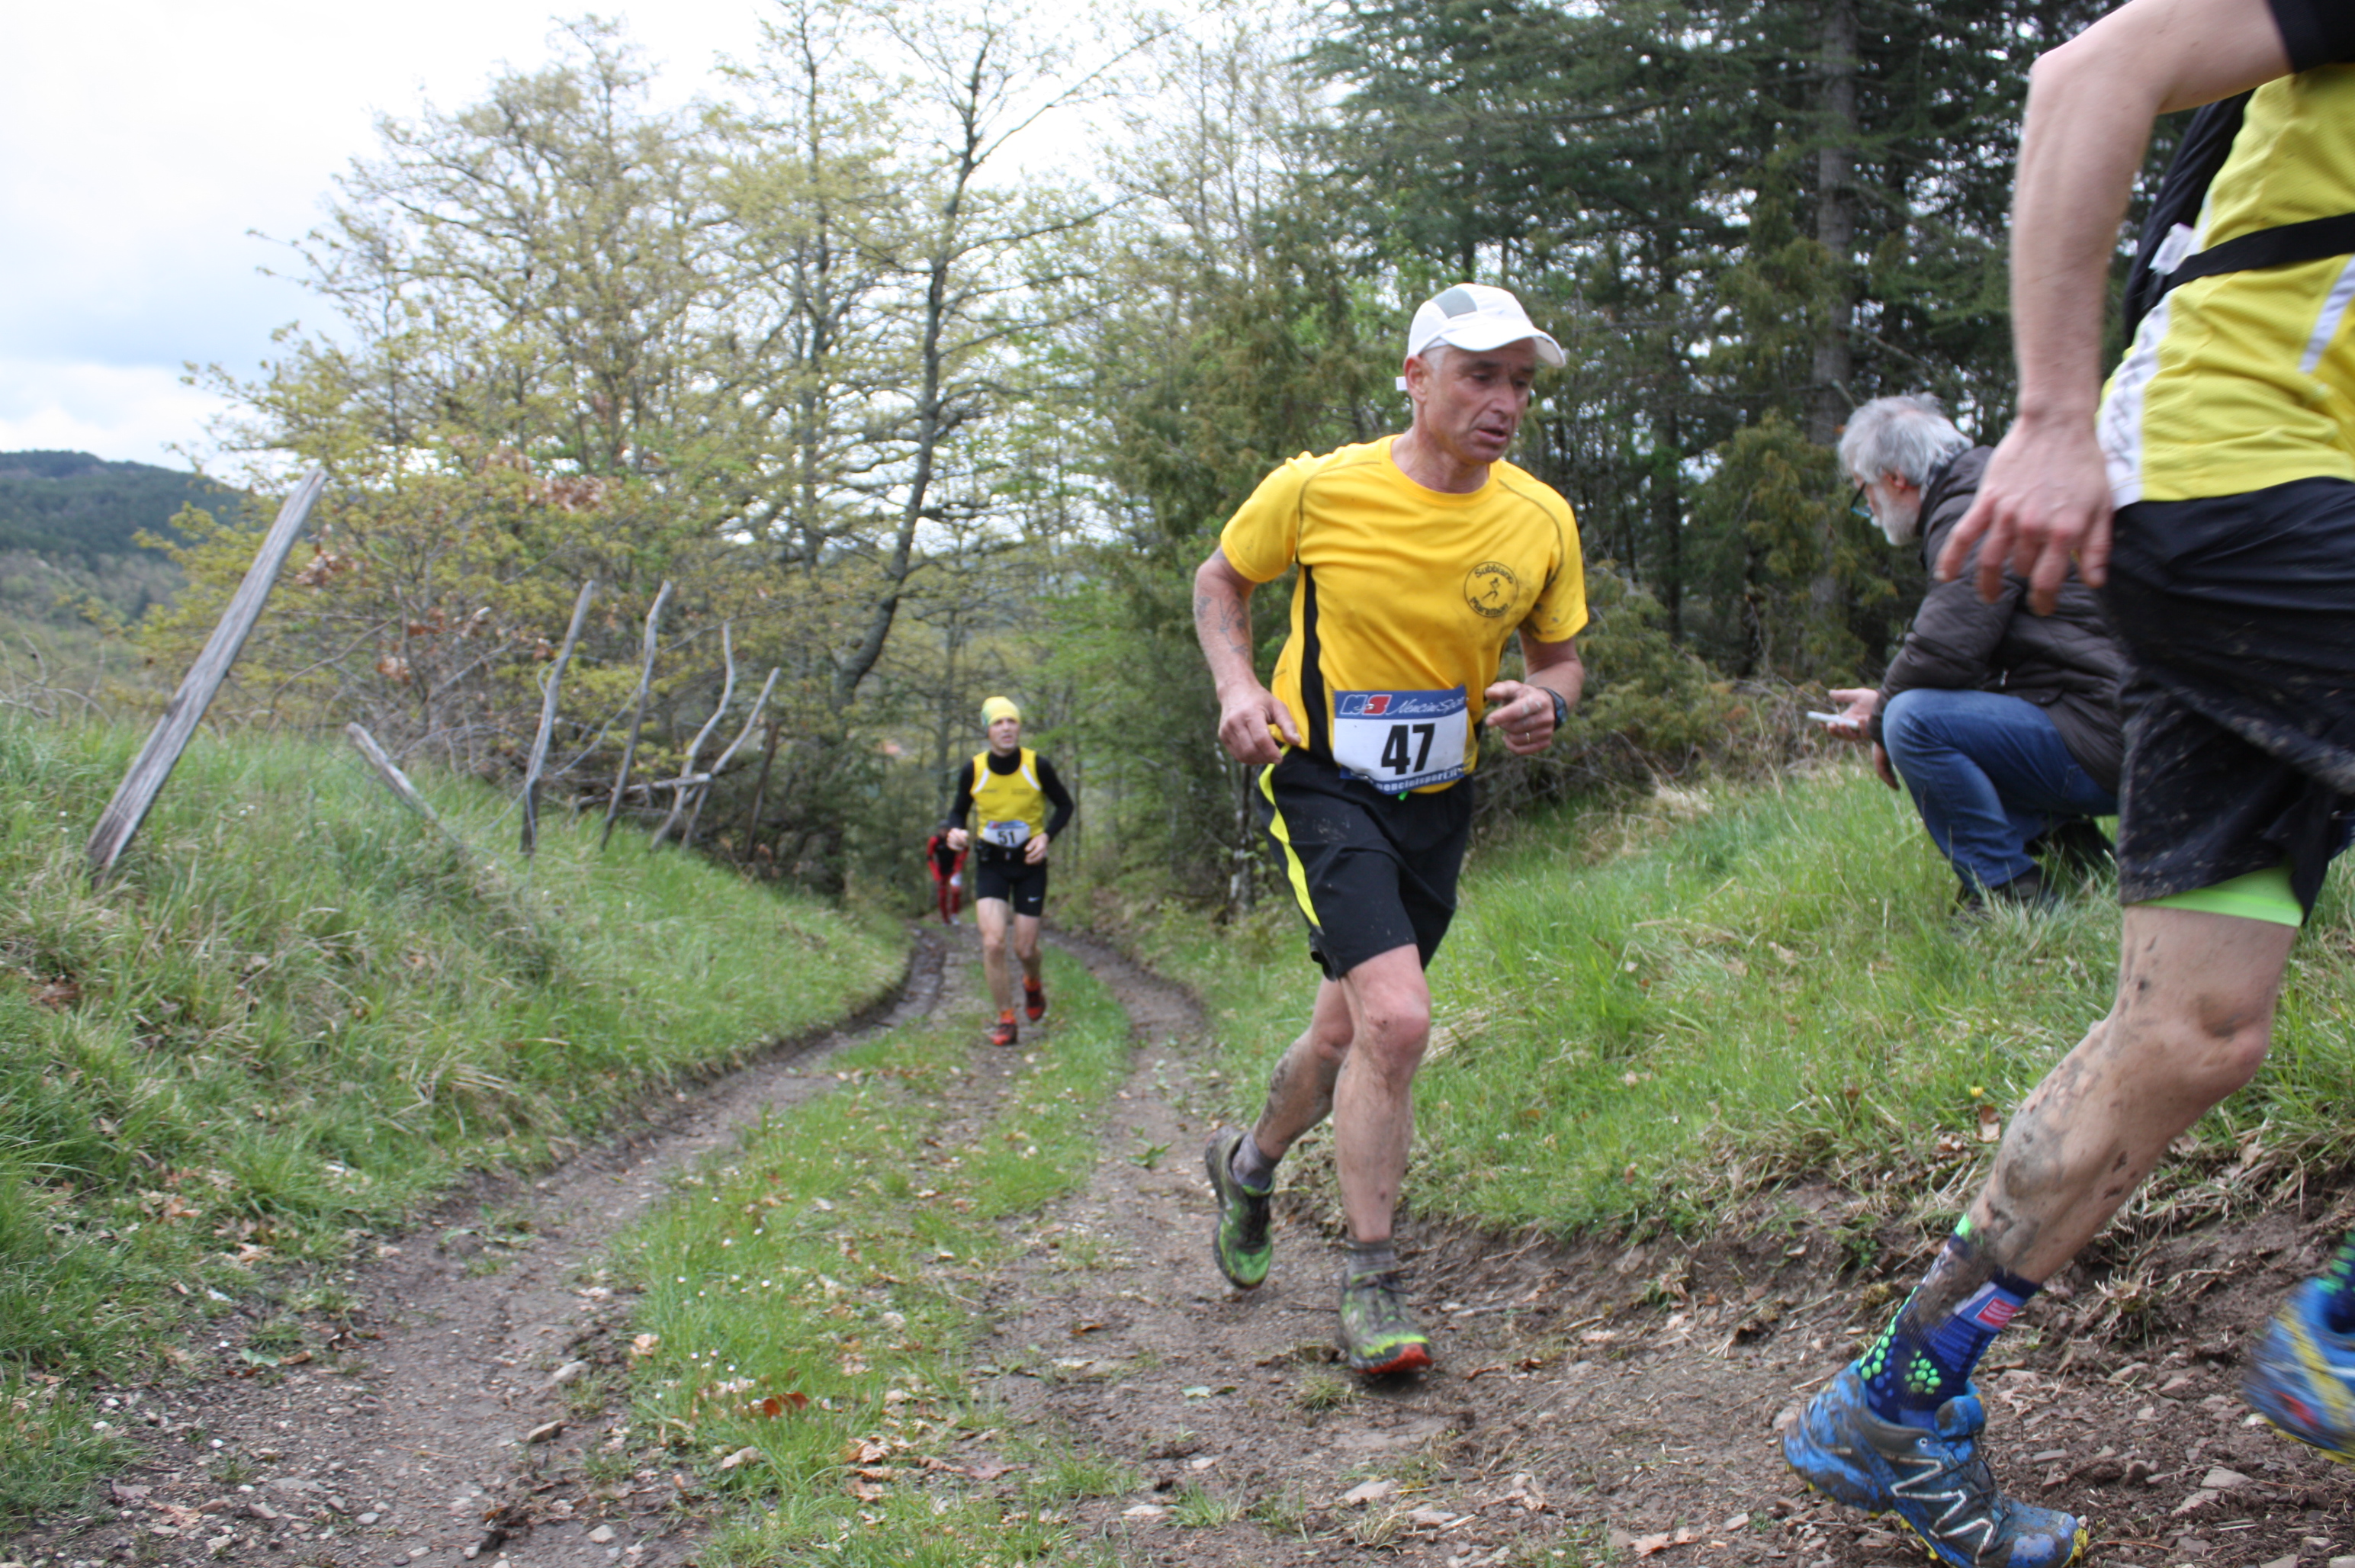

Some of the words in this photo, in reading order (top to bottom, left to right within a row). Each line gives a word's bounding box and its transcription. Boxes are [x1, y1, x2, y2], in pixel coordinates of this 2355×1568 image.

[1474, 564, 1514, 584] Subbiano
[1470, 596, 1508, 615] Marathon
[1381, 723, 1435, 776] 47
[1350, 768, 1457, 792] .nencinisport.it
[998, 830, 1016, 845] 51
